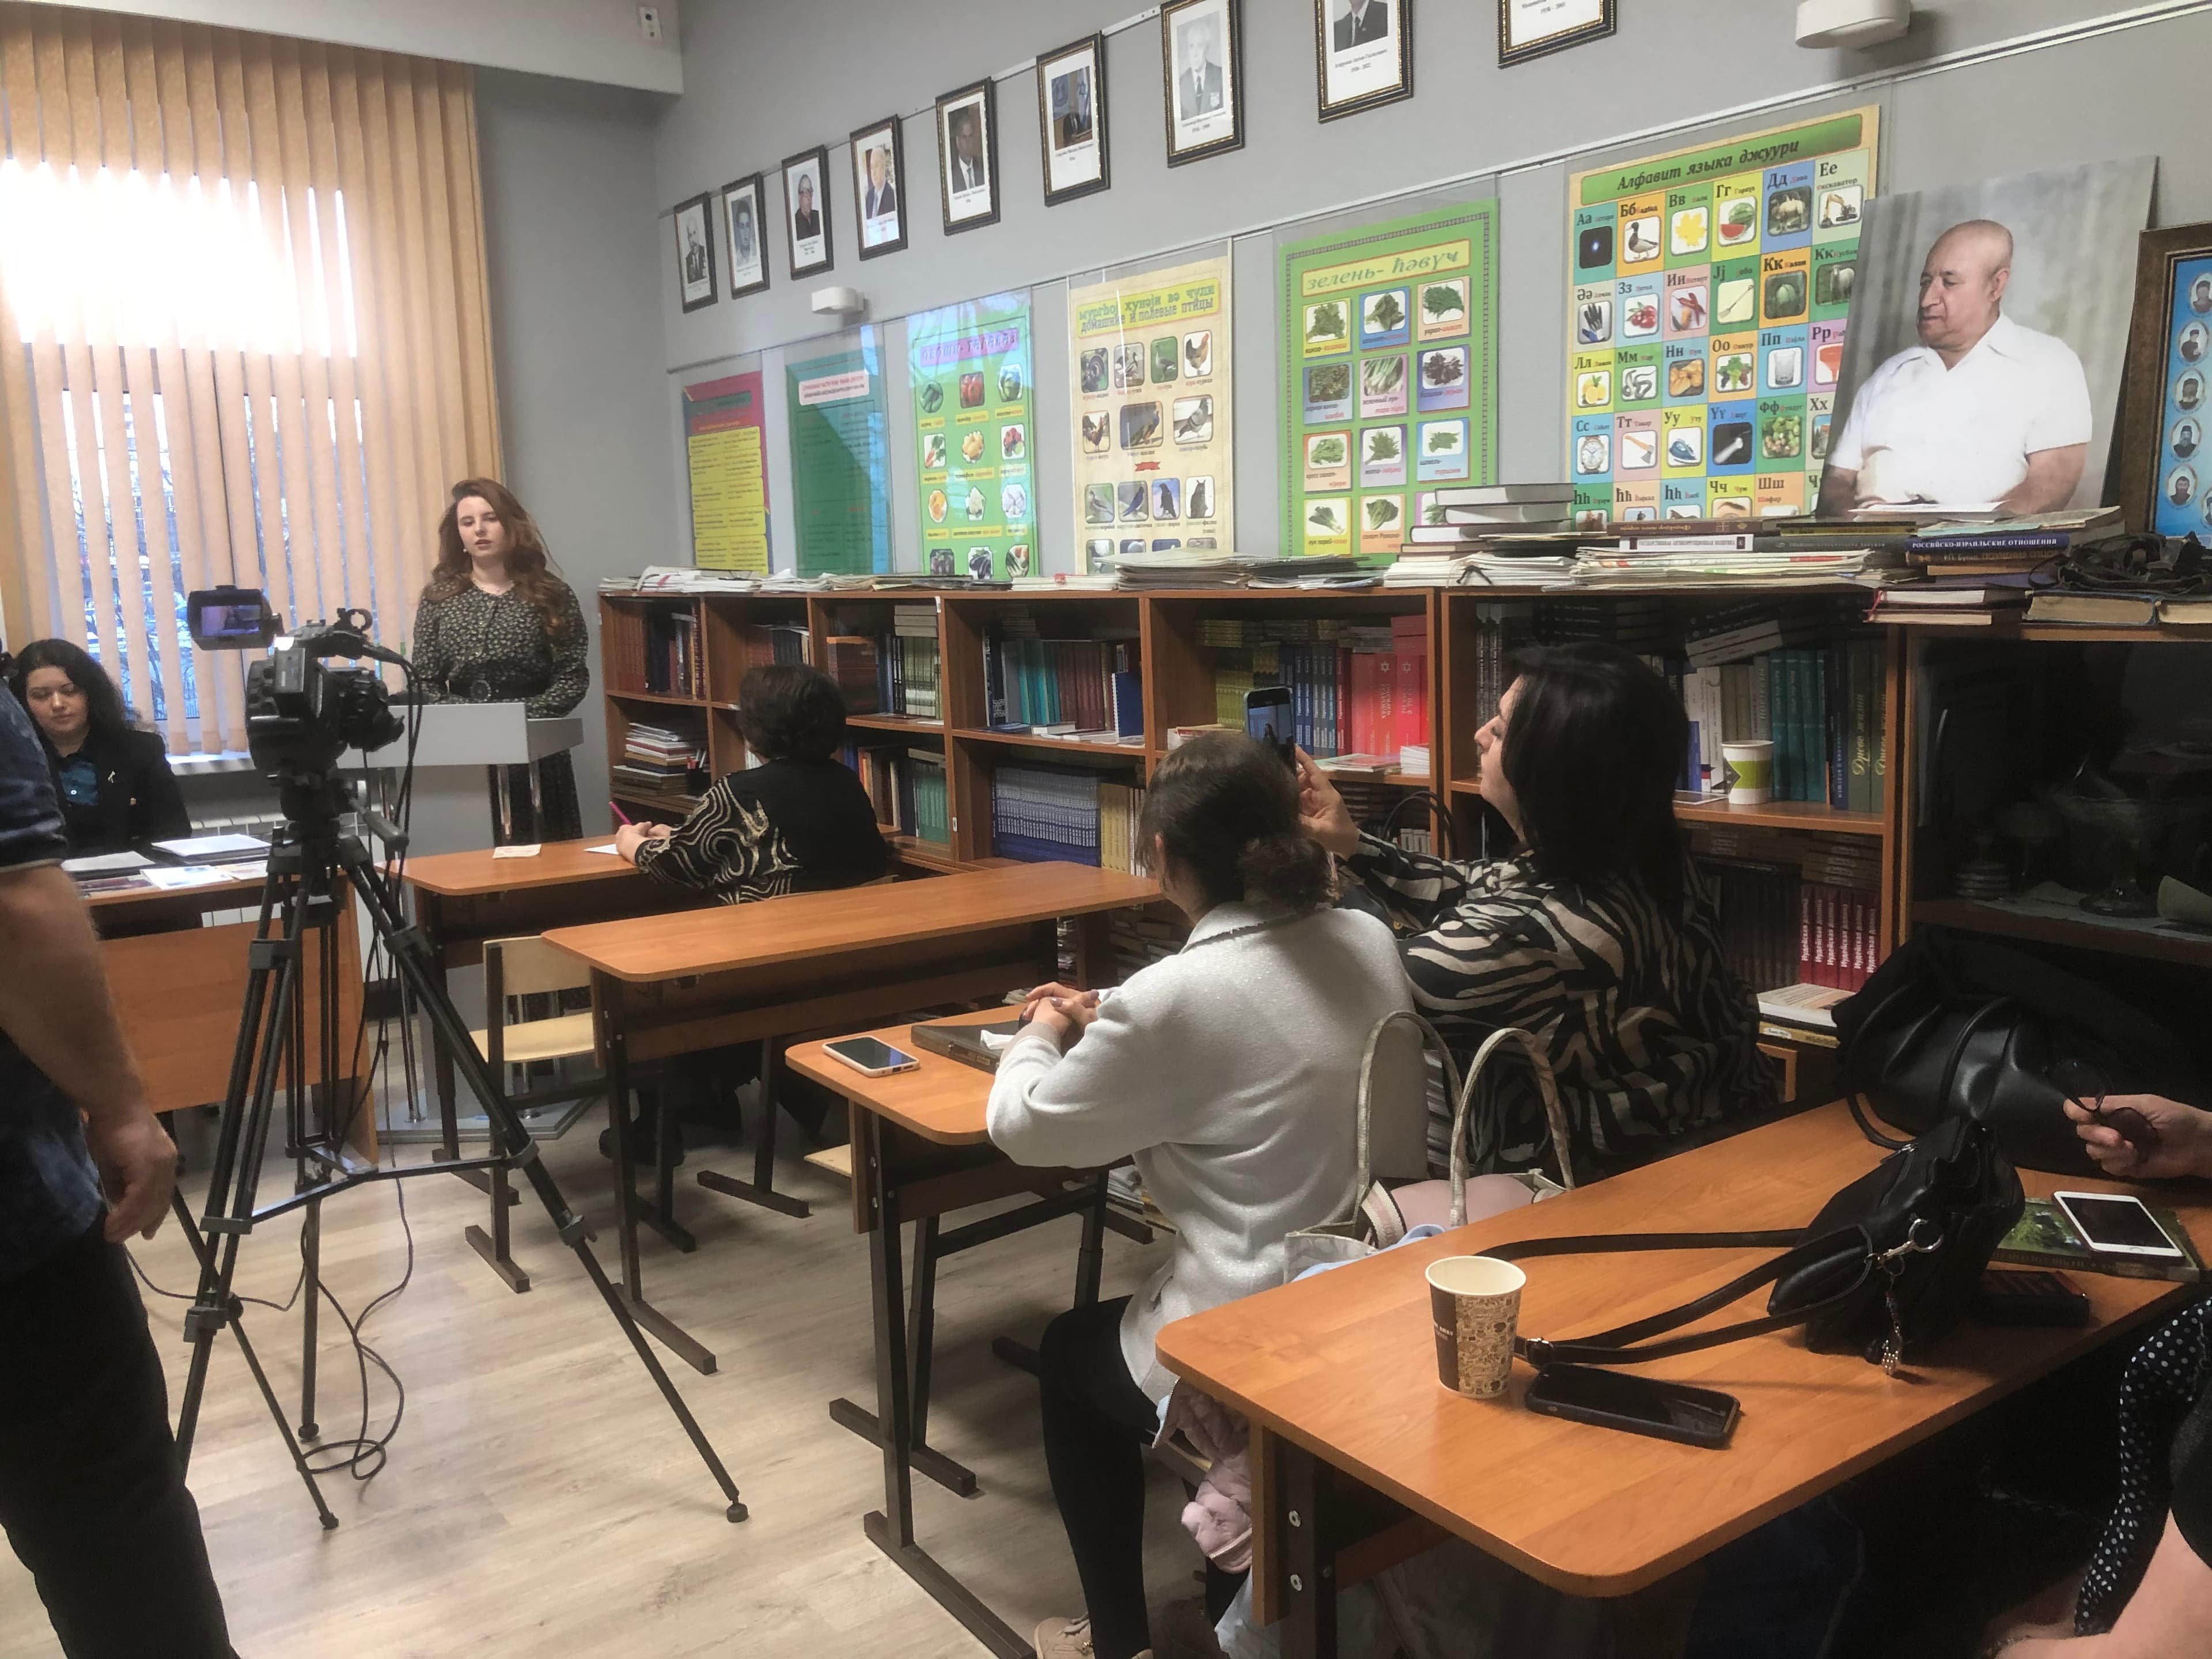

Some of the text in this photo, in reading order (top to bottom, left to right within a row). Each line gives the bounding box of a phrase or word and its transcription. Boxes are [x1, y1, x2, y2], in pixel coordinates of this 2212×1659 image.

[1618, 141, 1800, 190] Алфавит языка джуури
[1767, 173, 1787, 190] Дд
[1715, 184, 1732, 198] Гг
[1669, 194, 1685, 207] Вв
[1620, 202, 1636, 217] Бб
[1577, 213, 1592, 225] Аа
[1618, 282, 1632, 294] Зз
[1130, 313, 1136, 323] и
[1138, 305, 1177, 321] полевые
[1181, 297, 1214, 313] птицы
[1762, 333, 1781, 346] Пп
[1618, 351, 1637, 363] Мм
[1666, 346, 1684, 358] Нн
[1574, 357, 1591, 369] Лл
[1809, 397, 1828, 411] Хх
[1576, 420, 1589, 432] Сс
[1617, 416, 1632, 428] Тт
[1758, 477, 1785, 490] Шш
[1912, 538, 2058, 548] РОССИЙСКО-ИЗРАИЛЬСКИЕ ОТНОШЕНИЯ
[1851, 736, 1870, 775] Древо
[1802, 925, 1810, 961] Иудейская
[1815, 926, 1823, 963] Иудейская
[1827, 929, 1836, 965] Иудейская
[1840, 931, 1850, 967] Иудейская
[1854, 932, 1863, 969] Иудейская
[1866, 935, 1876, 973] Иудейская
